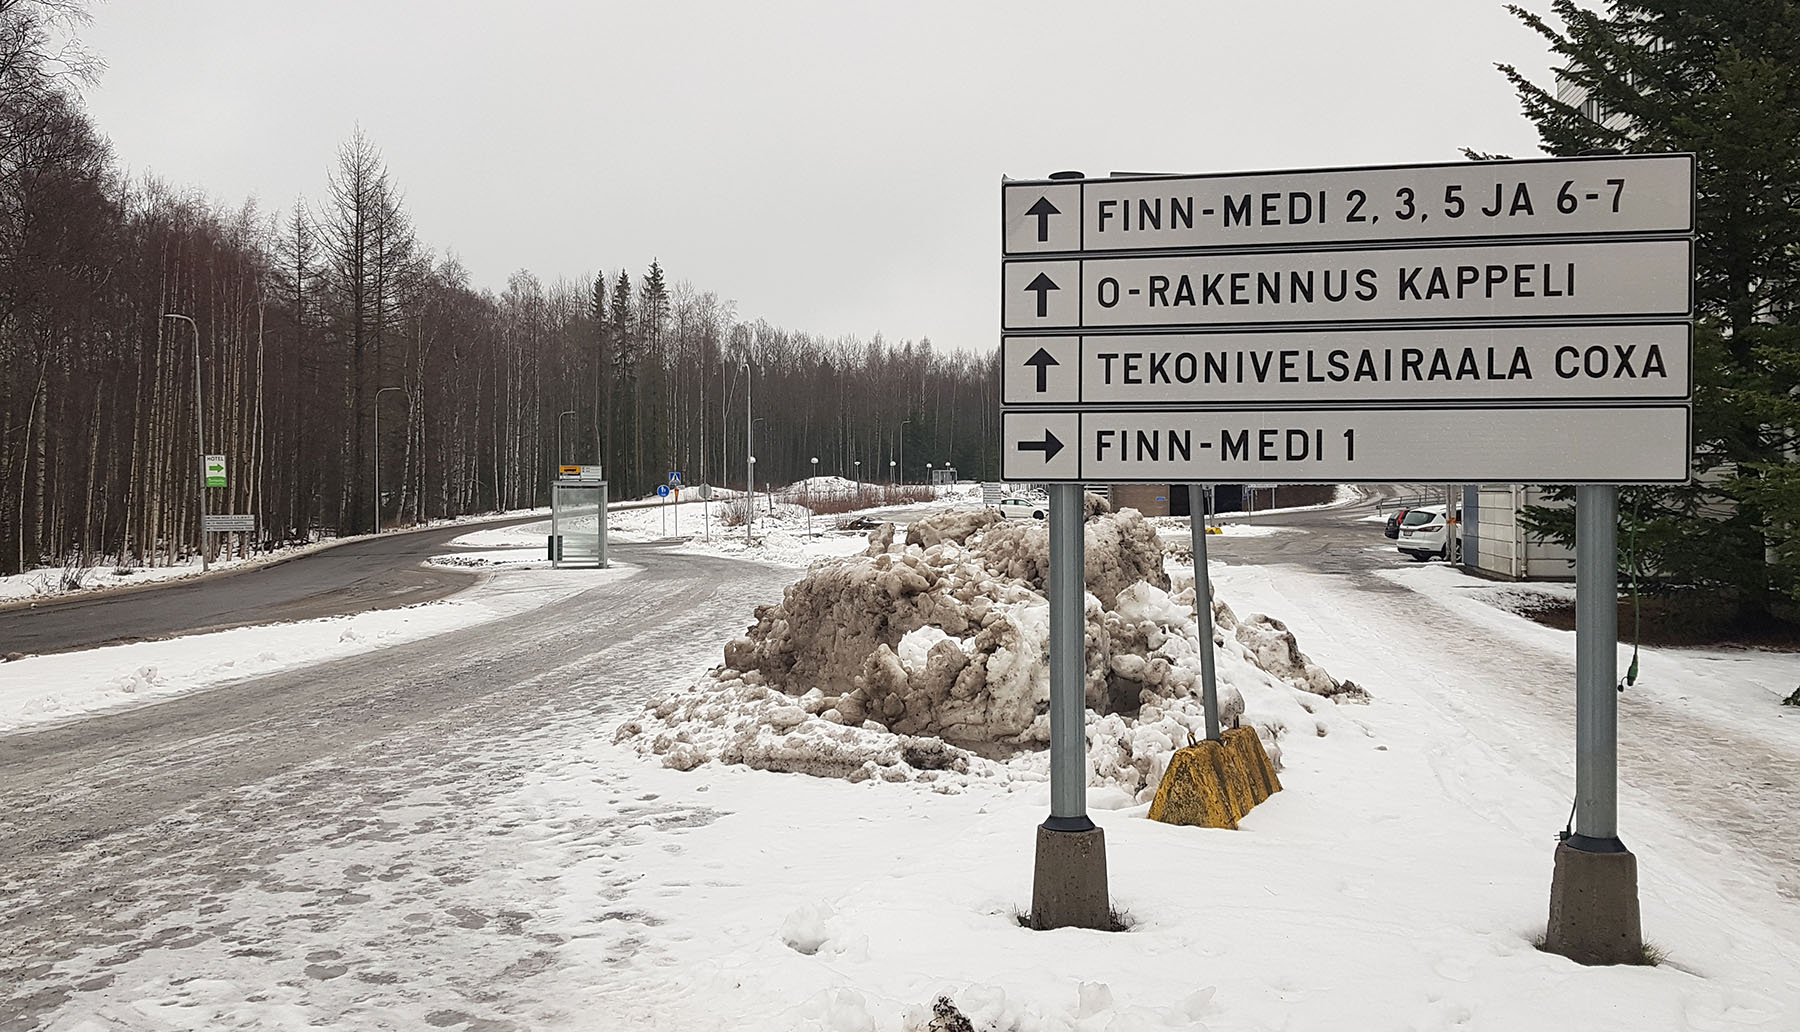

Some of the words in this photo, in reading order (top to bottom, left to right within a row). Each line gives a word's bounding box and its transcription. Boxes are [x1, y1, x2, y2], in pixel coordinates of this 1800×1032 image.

[1098, 190, 1326, 233] FINN-MEDI
[1346, 189, 1379, 225] 2,
[1395, 187, 1428, 224] 3,
[1444, 184, 1465, 219] 5
[1481, 182, 1535, 218] JA
[1556, 178, 1625, 215] 6-7
[1097, 265, 1380, 309] O-RAKENNUS
[1398, 262, 1575, 301] KAPPELI
[1097, 347, 1533, 385] TEKONIVELSAIRAALA
[1555, 344, 1668, 380] COXA
[1096, 428, 1323, 462] FINN-MEDI
[1343, 428, 1354, 462] 1
